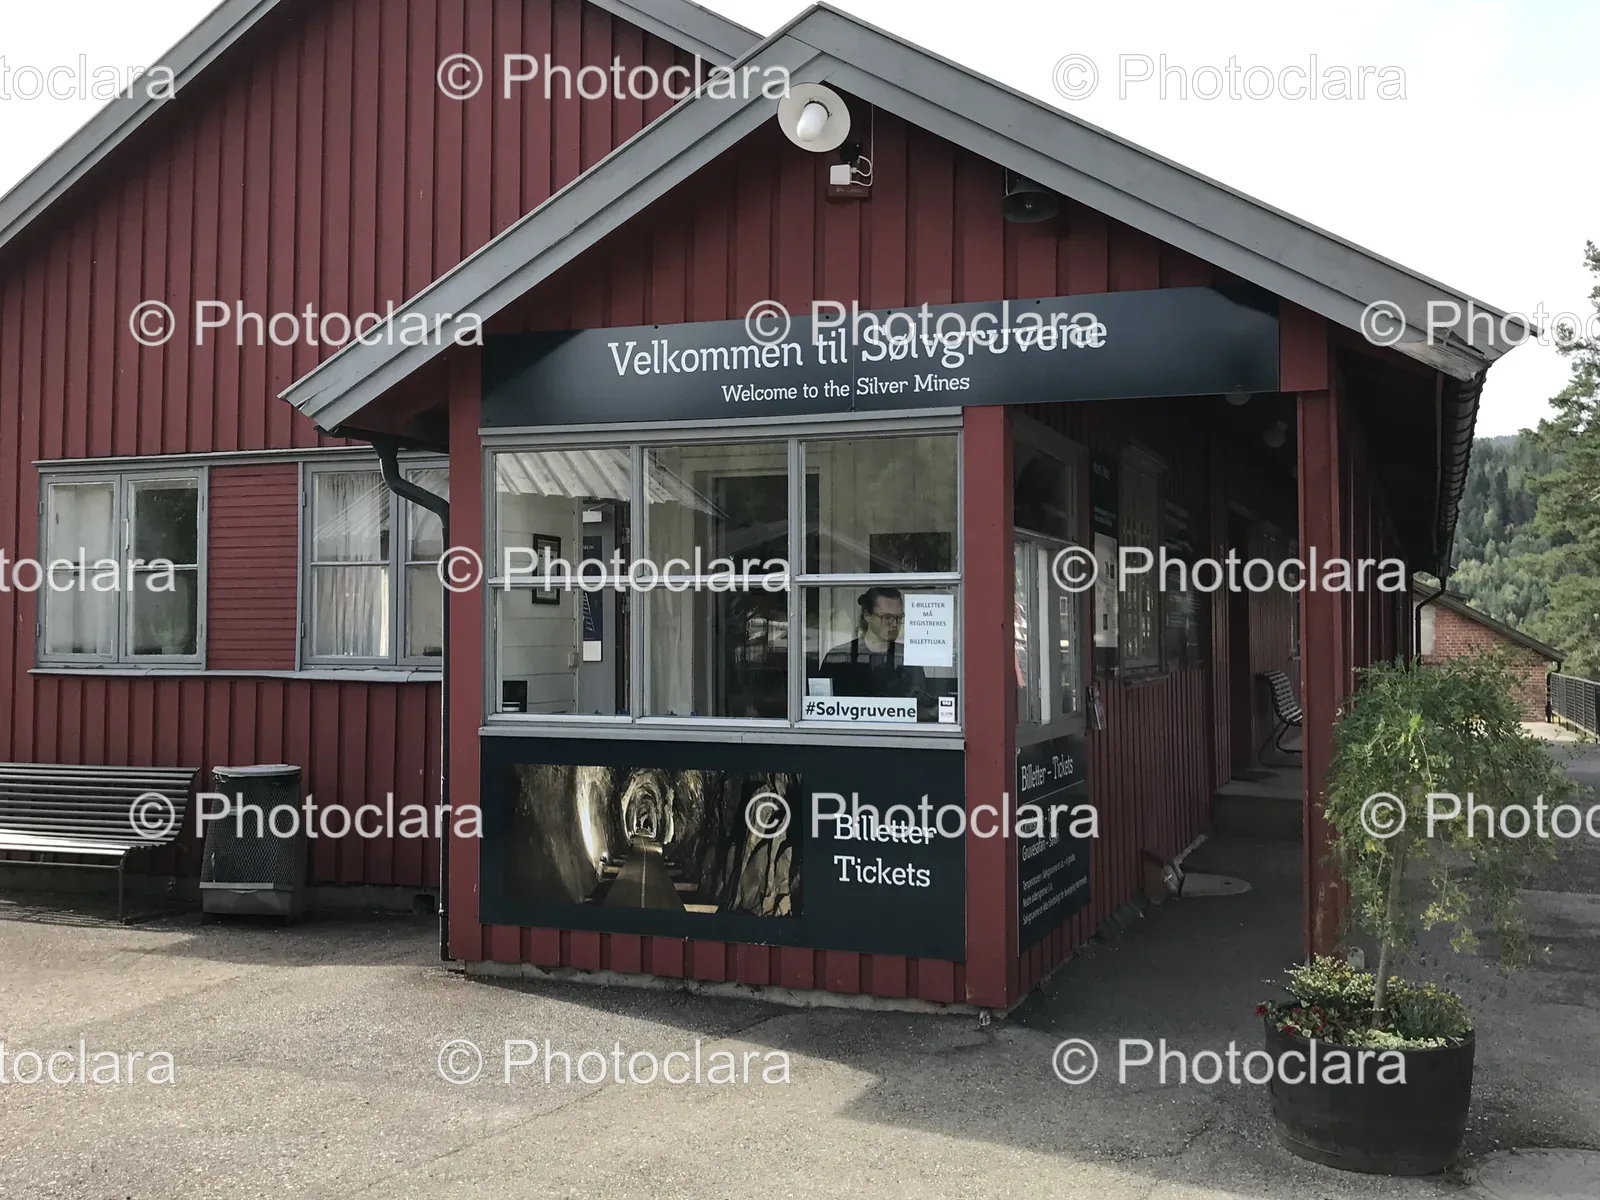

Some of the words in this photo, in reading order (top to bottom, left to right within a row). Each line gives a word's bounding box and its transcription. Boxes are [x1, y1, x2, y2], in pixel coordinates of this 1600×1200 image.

[608, 340, 803, 376] Velkommen
[816, 328, 848, 365] til
[862, 321, 1107, 369] Sølvgruvene
[721, 384, 798, 402] Welcome
[803, 383, 819, 399] to
[823, 380, 850, 397] the
[856, 376, 909, 395] Silver
[913, 373, 970, 393] Mines
[805, 701, 916, 720] #Sølvgruvene
[1021, 763, 1047, 791] Billetter
[1052, 754, 1073, 779] Tickets
[833, 813, 938, 845] Billetter
[833, 855, 931, 888] Tickets
